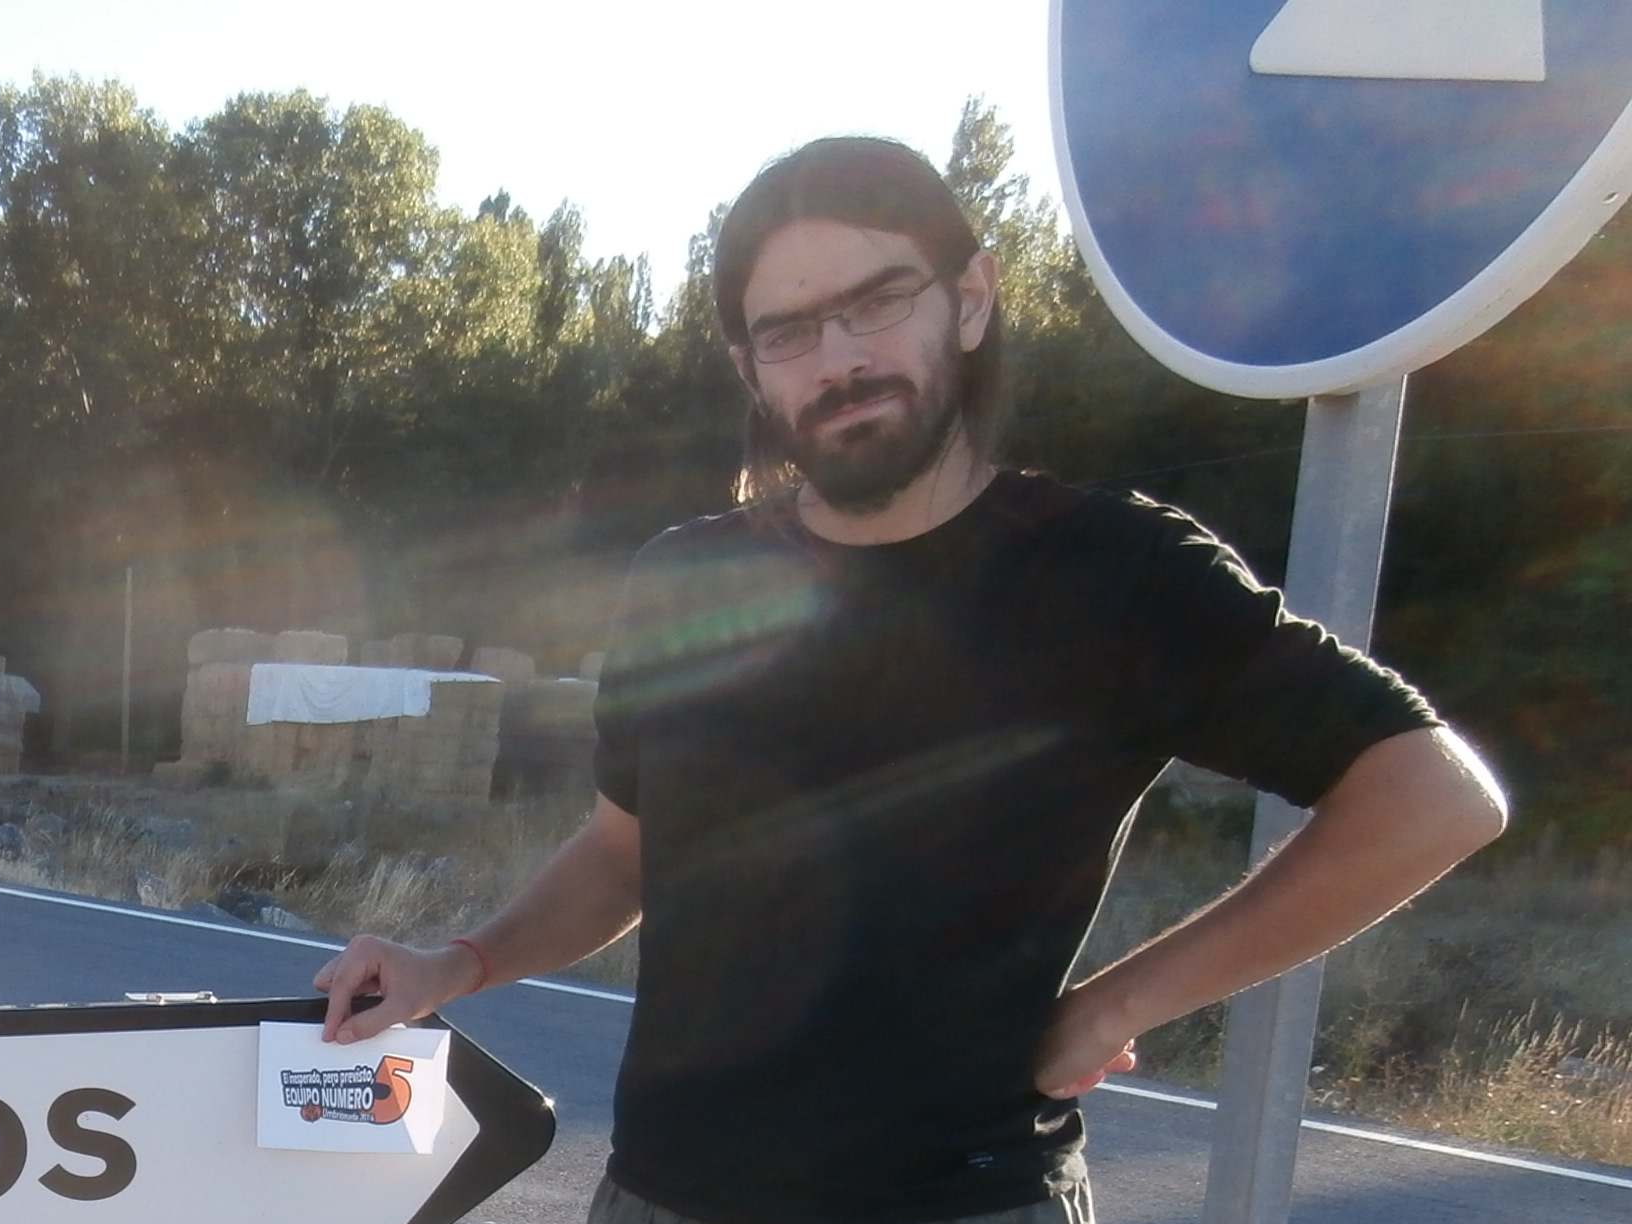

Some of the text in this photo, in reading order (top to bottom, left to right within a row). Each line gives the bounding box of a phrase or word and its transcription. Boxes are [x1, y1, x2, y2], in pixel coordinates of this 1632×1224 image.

[285, 1087, 320, 1106] EQUIPO
[374, 1054, 414, 1125] 5
[323, 1073, 339, 1086] pero
